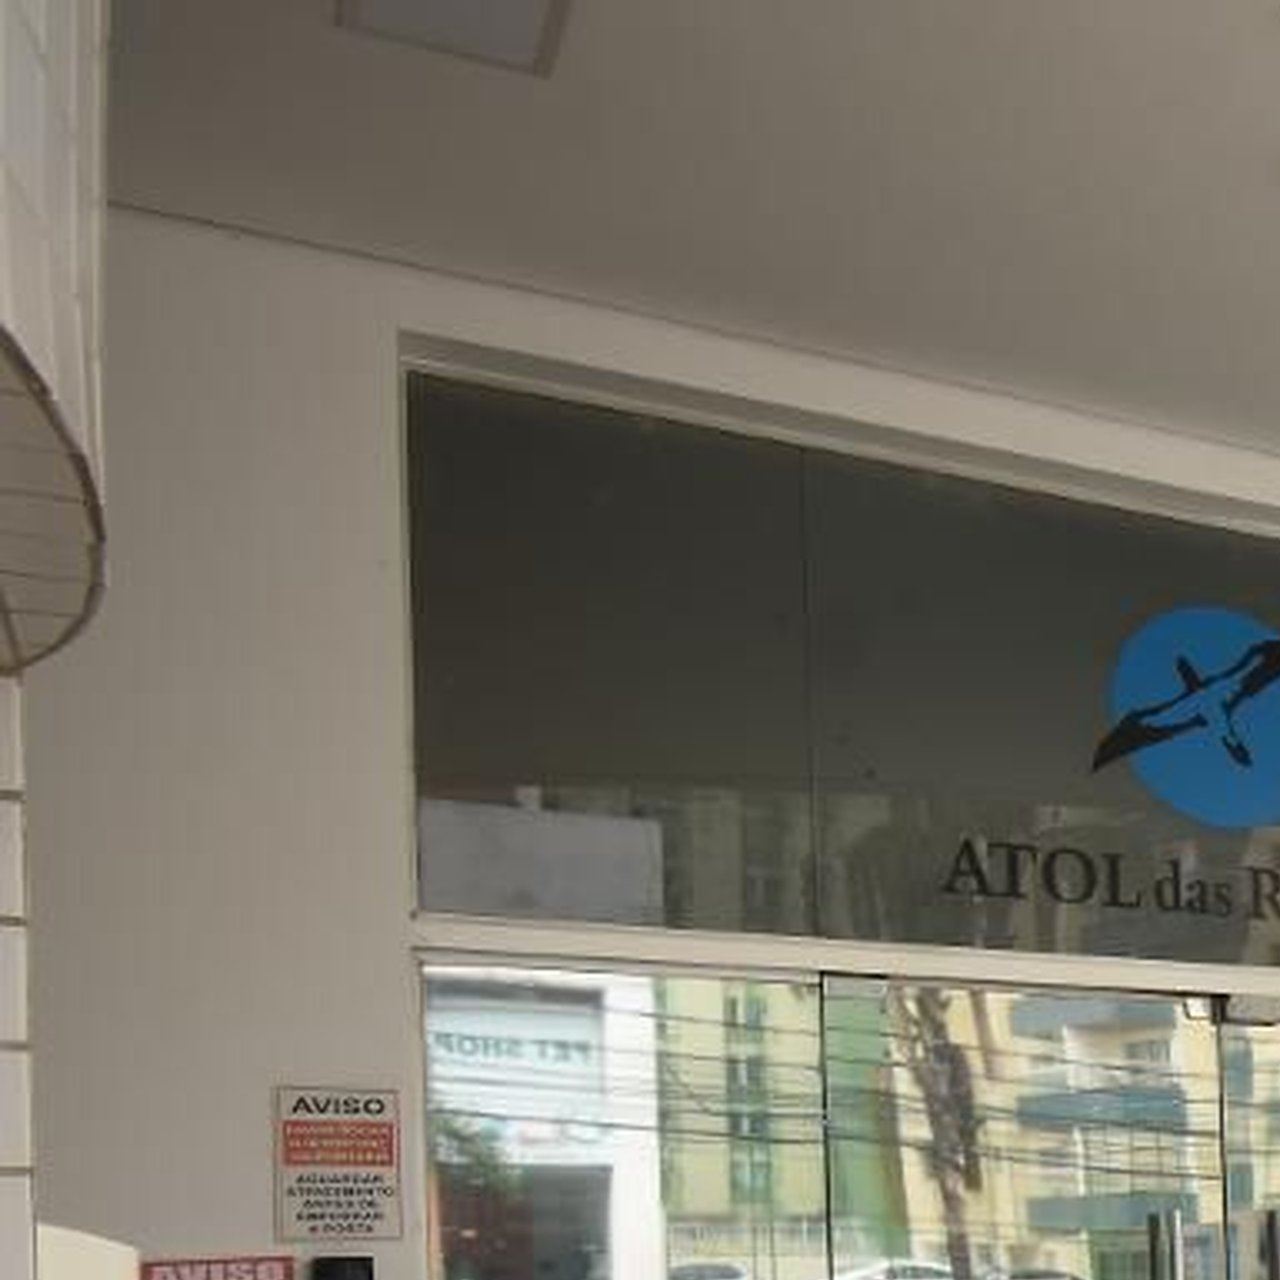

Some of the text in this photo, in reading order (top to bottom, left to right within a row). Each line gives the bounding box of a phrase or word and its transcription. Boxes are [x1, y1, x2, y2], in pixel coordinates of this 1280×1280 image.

[942, 838, 1141, 908] ATOL
[1155, 859, 1233, 918] das
[292, 1096, 385, 1115] AVISO
